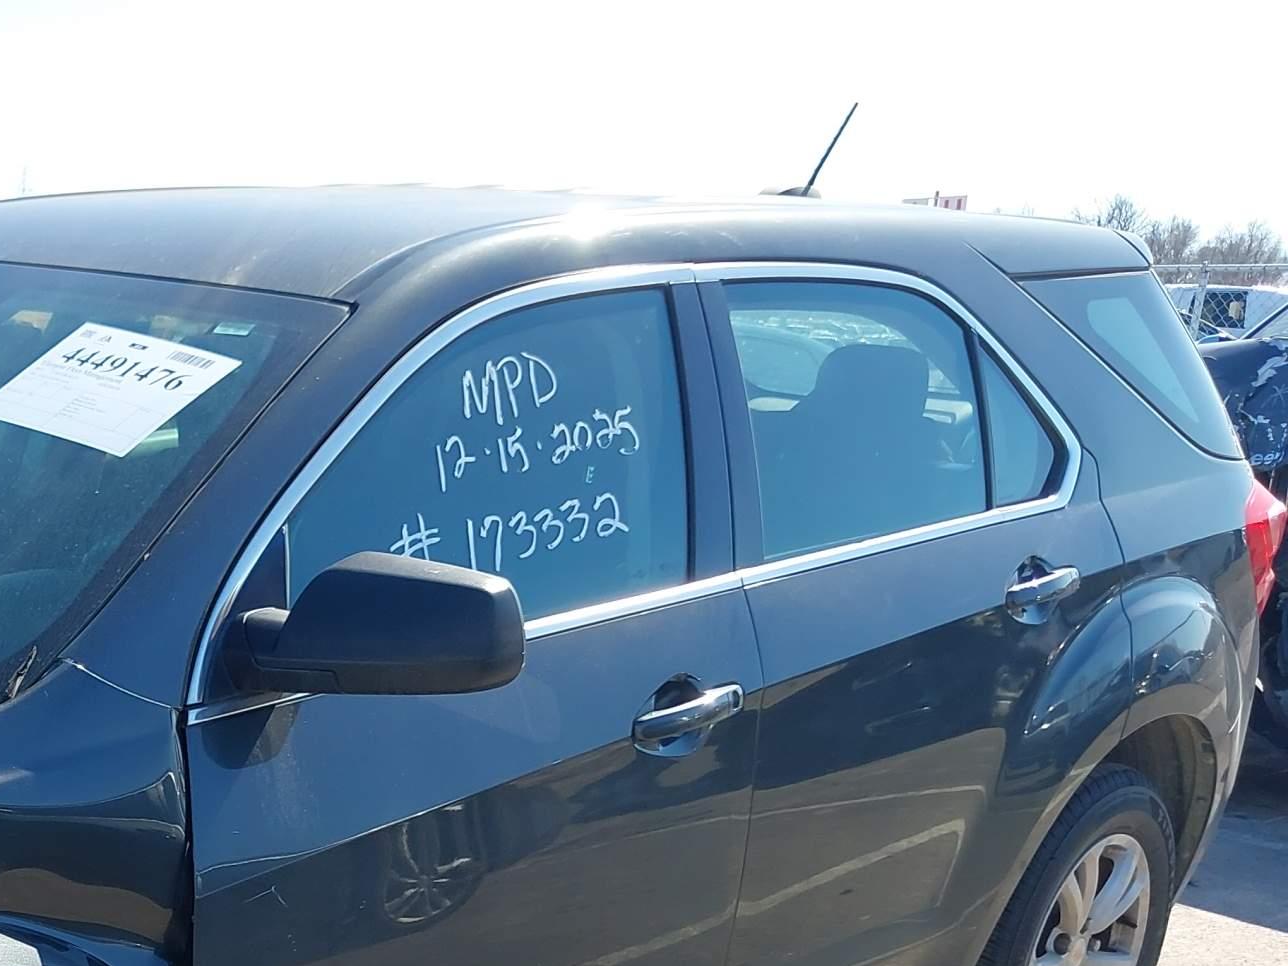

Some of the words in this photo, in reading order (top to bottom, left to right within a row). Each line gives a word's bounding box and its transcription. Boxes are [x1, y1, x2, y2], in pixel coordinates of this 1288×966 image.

[62, 347, 192, 390] 44491476
[462, 352, 557, 425] MPD
[389, 513, 441, 561] #
[466, 493, 630, 572] 173332
